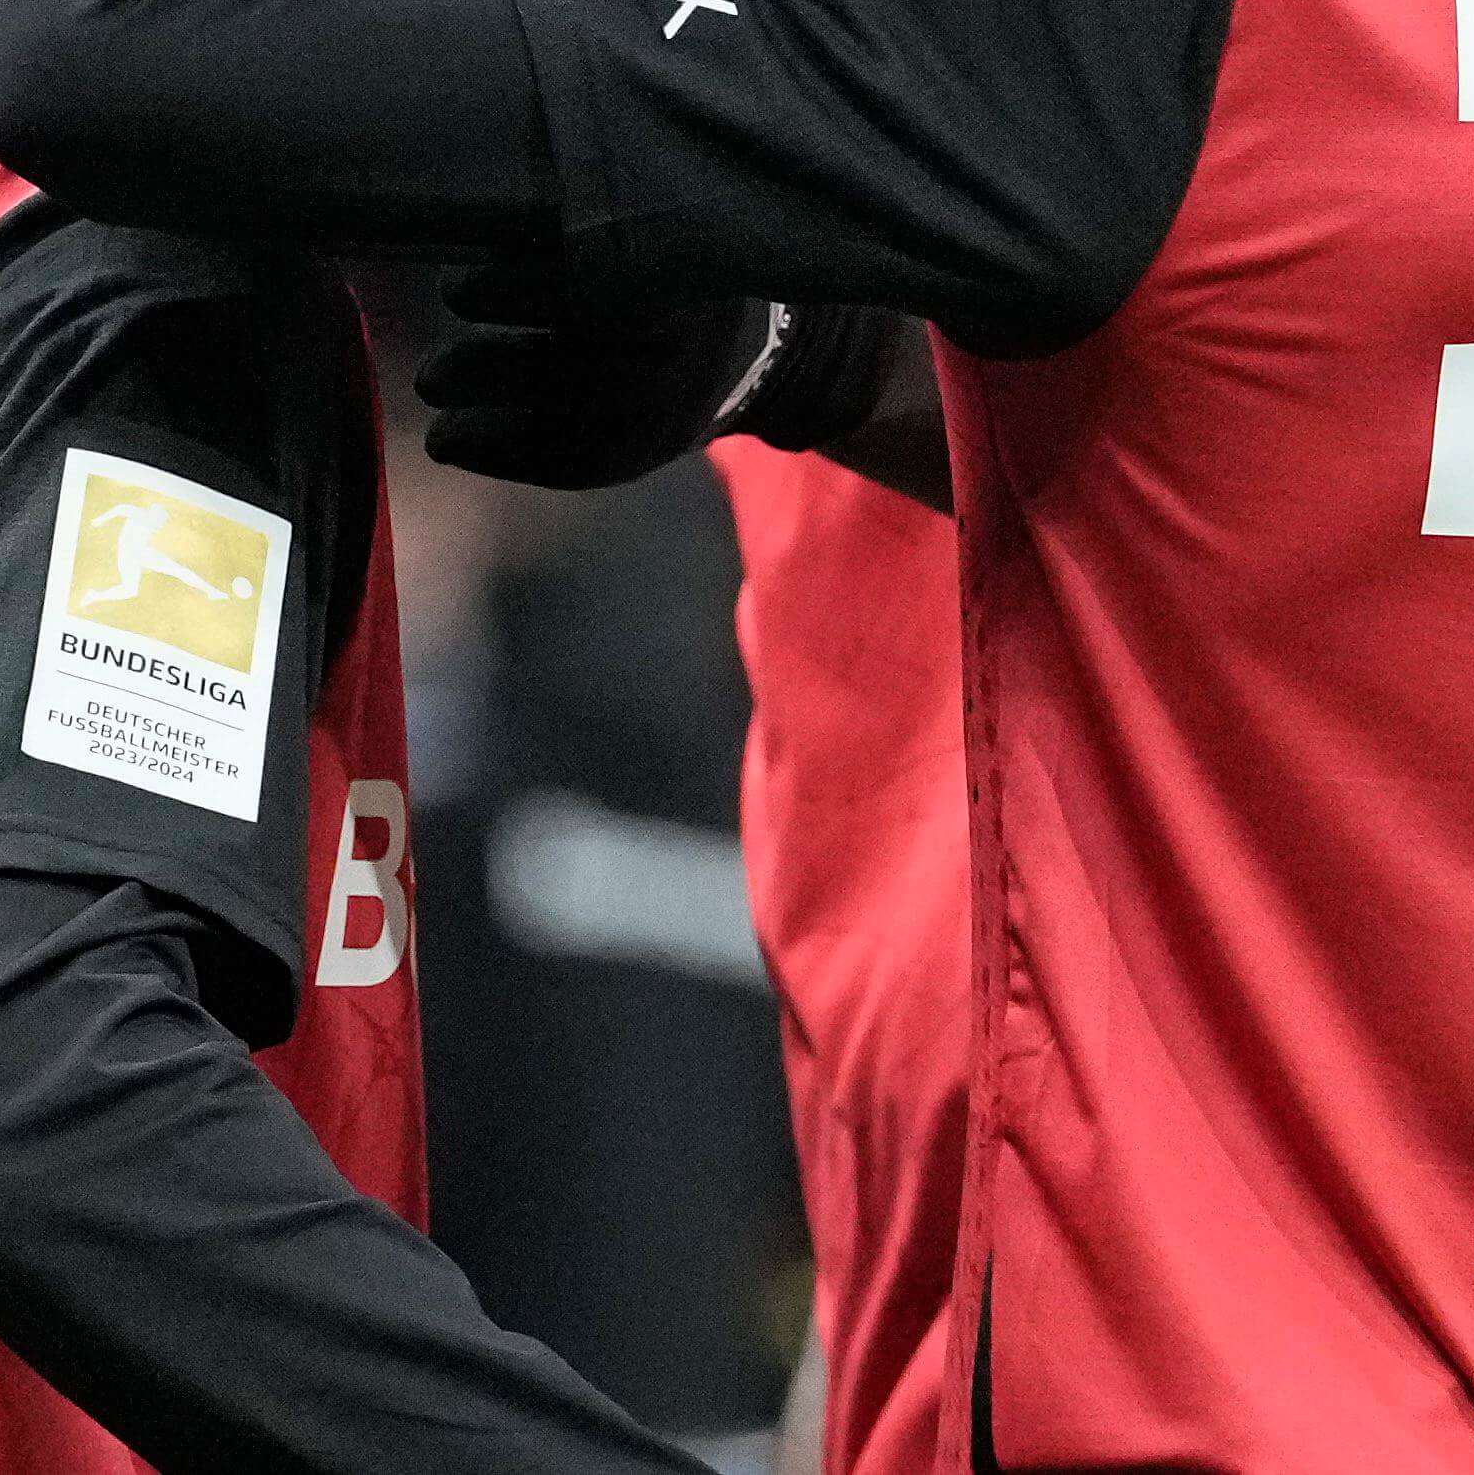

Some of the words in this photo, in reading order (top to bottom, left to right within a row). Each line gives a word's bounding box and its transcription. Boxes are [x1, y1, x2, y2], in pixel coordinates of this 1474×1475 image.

[60, 632, 247, 710] BUNDESLIGA
[48, 709, 240, 779] FUSSBALLMEISTER
[86, 700, 207, 750] DEUTSCHER
[89, 739, 195, 783] 2023/2024
